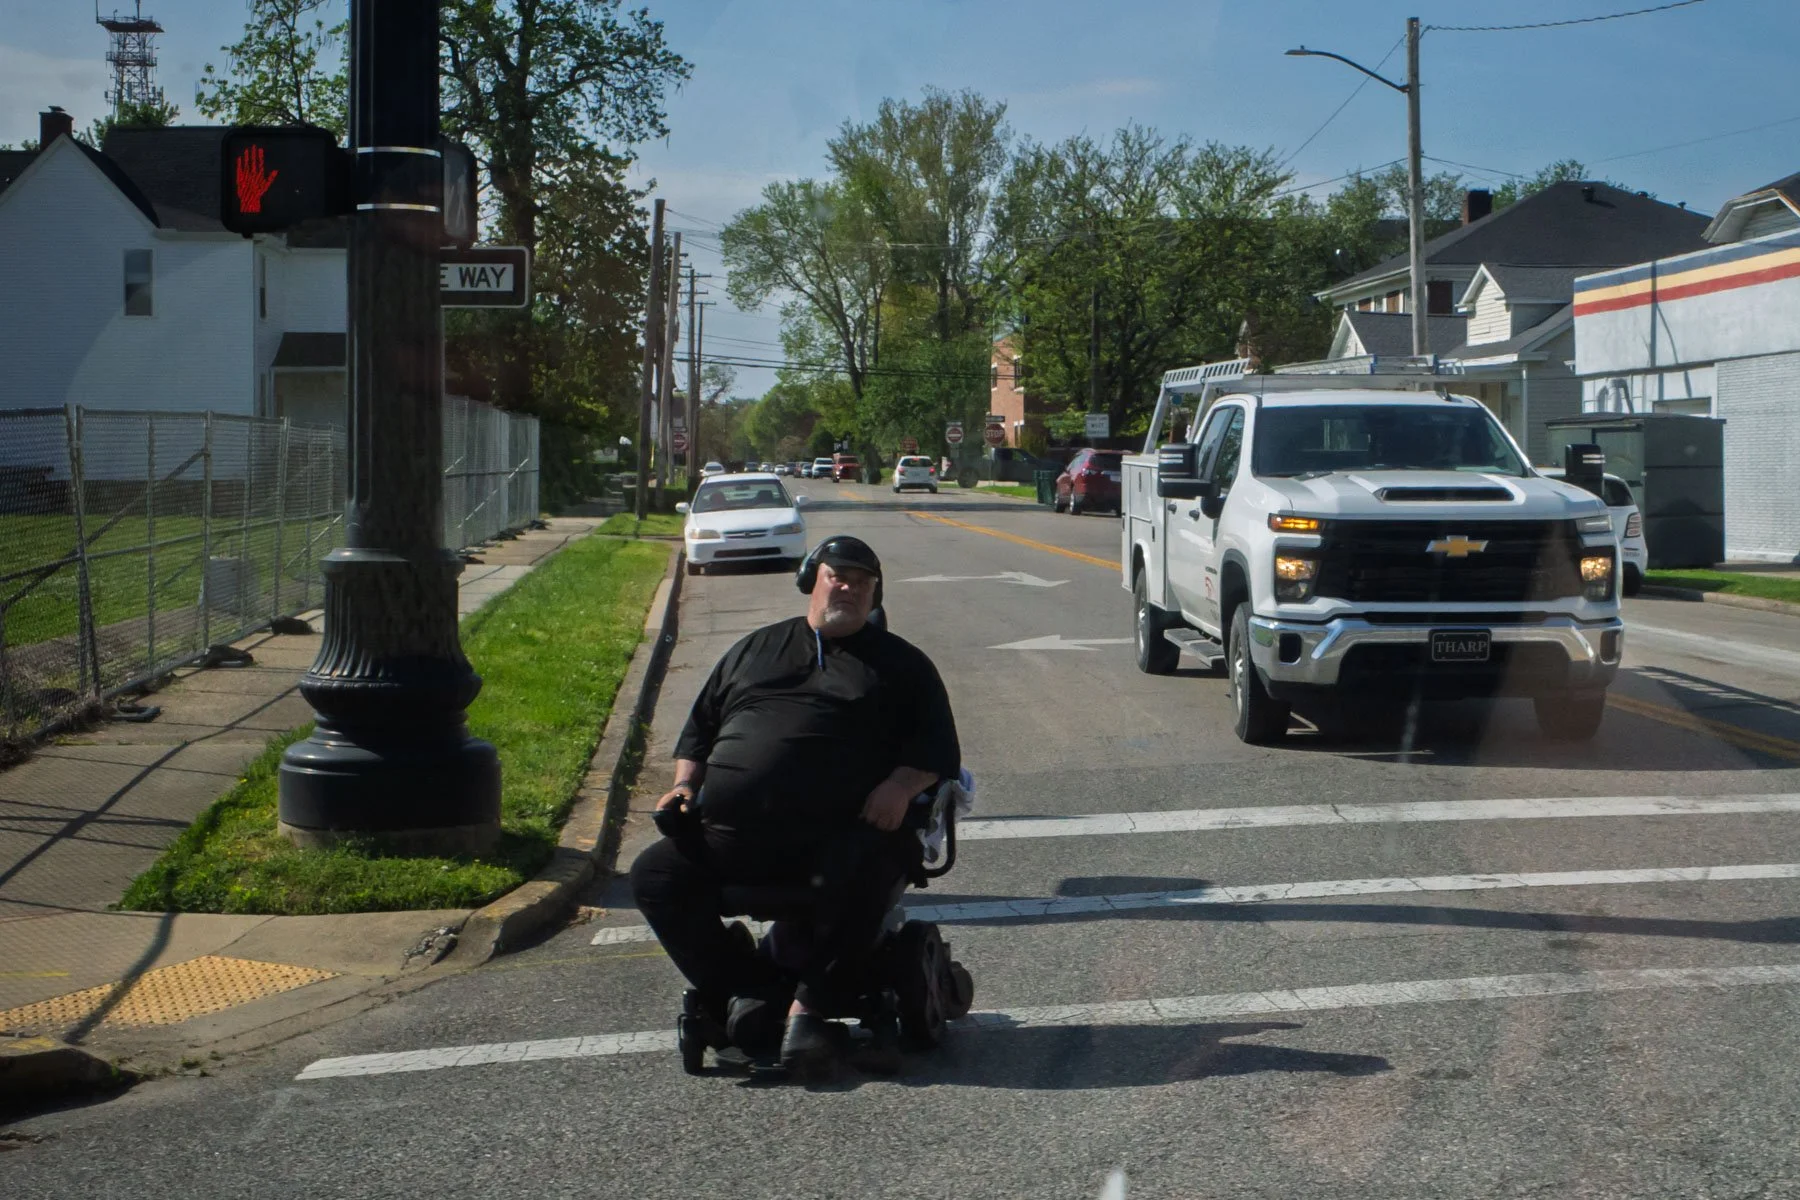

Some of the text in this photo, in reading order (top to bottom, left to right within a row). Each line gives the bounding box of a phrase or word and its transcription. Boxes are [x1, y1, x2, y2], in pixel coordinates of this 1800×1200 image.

[458, 266, 507, 288] WAY
[986, 429, 1004, 438] STOP
[1435, 641, 1488, 653] THARP
